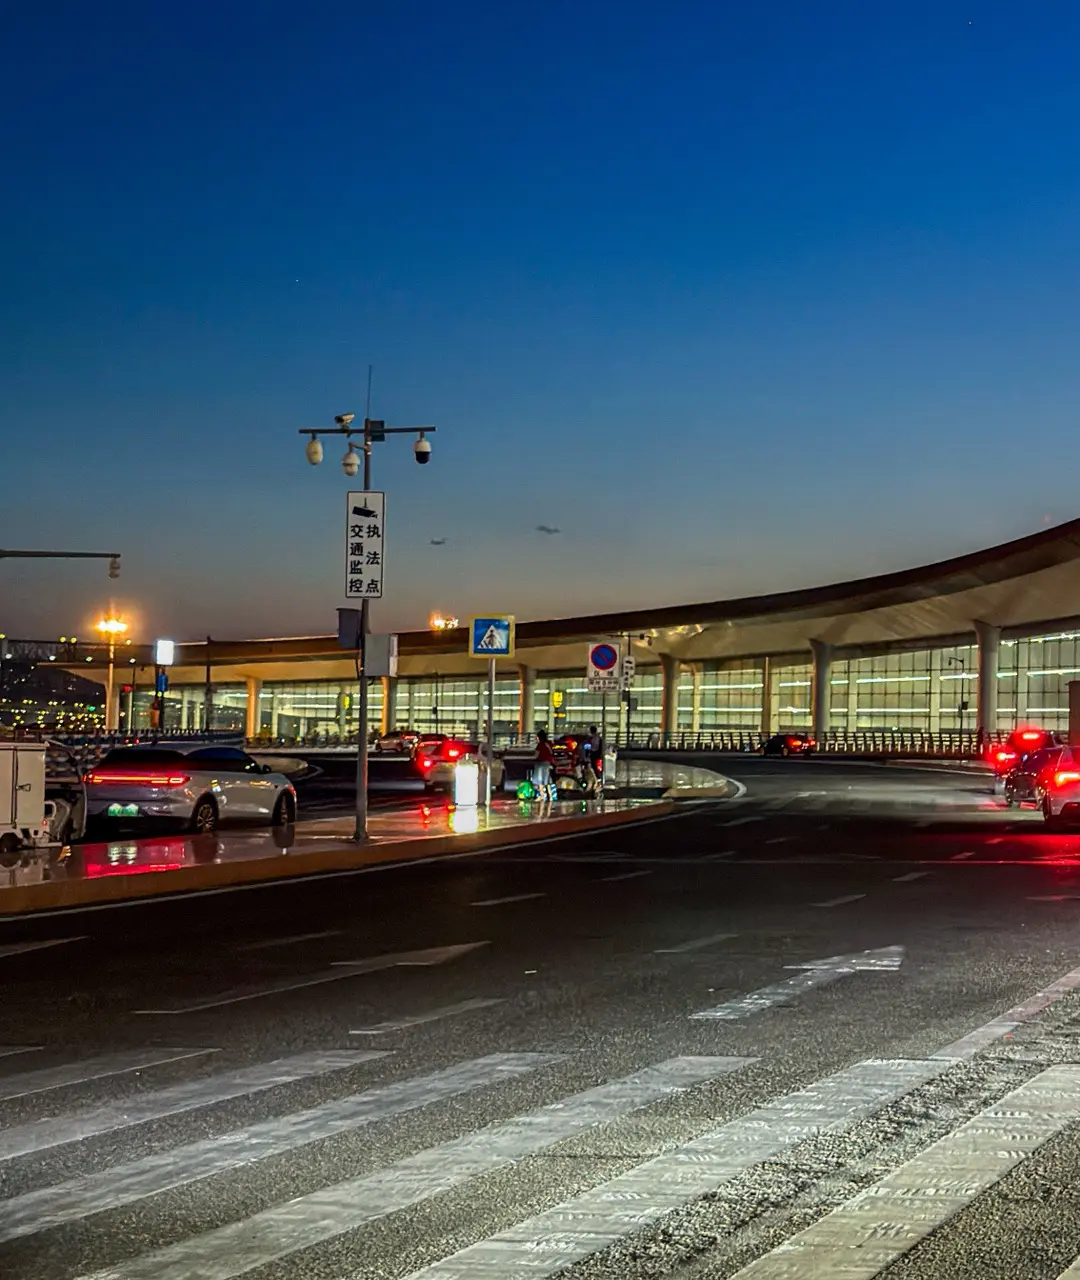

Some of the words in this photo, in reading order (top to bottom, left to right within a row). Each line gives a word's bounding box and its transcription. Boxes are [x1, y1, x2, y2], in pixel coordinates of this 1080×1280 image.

[349, 524, 364, 593] 交通监控
[365, 524, 381, 593] 执法点
